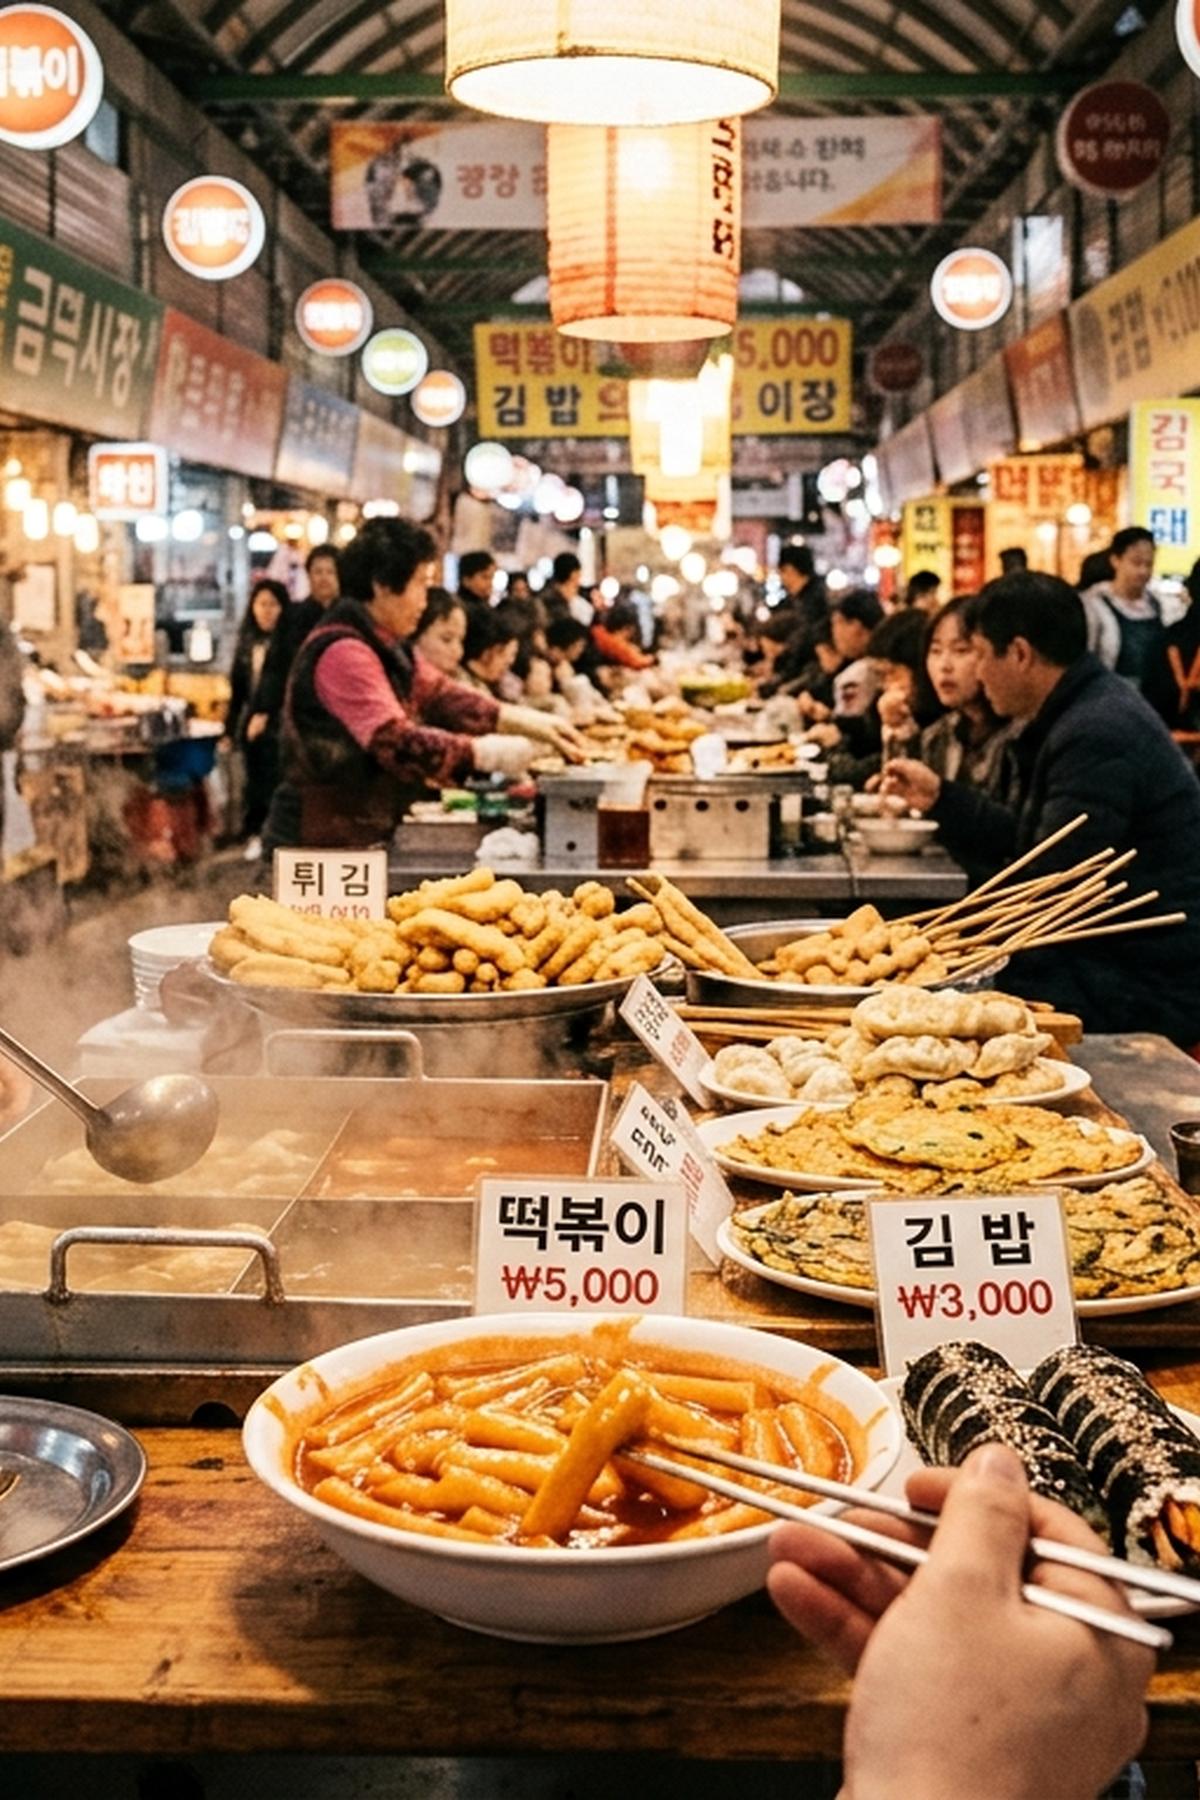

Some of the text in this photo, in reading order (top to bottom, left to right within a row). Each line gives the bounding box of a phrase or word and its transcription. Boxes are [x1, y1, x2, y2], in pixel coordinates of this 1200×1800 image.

[499, 1196, 664, 1254] 떡볶이
[502, 1265, 659, 1307] ₩5,000
[897, 1279, 1053, 1321] ₩3,000
